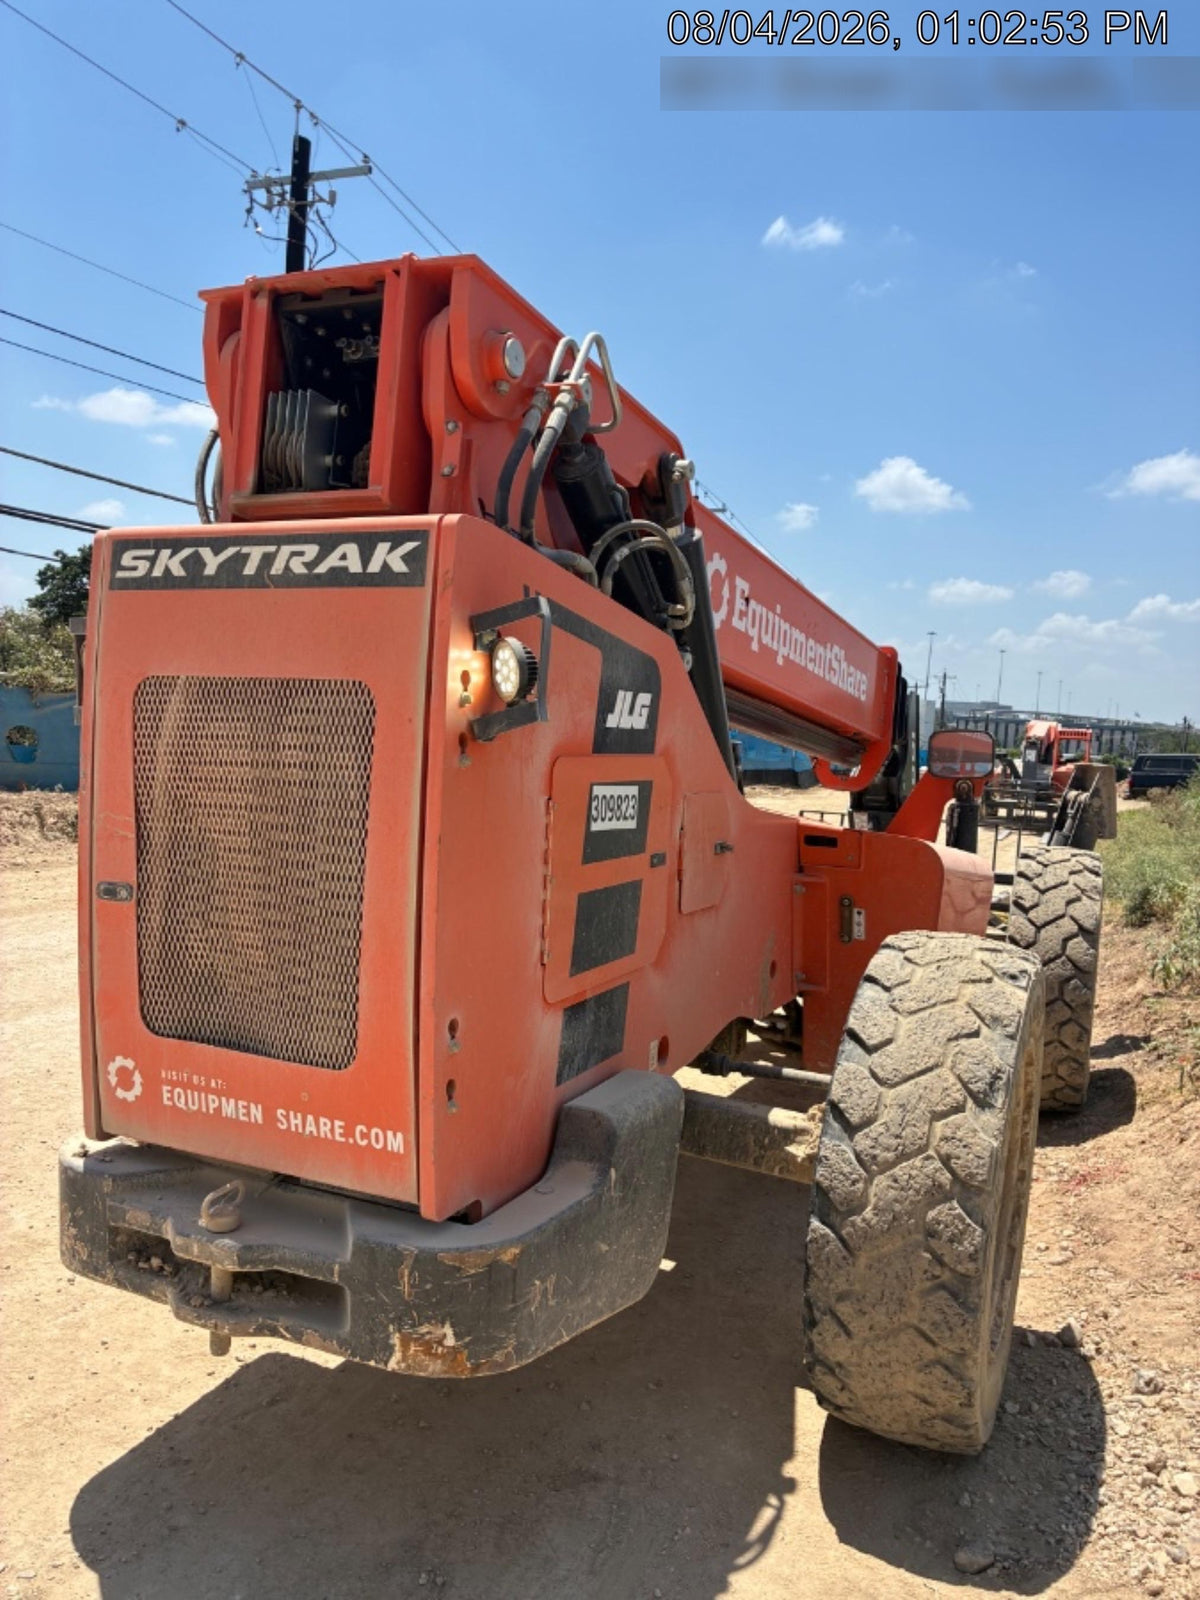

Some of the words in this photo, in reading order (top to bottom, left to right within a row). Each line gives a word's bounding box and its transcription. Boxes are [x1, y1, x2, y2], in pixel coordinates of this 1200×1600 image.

[115, 541, 421, 578] SKYTRAK
[732, 575, 868, 701] EquipmentShare
[605, 689, 652, 729] JLG
[591, 793, 637, 823] 309823
[193, 1075, 206, 1086] US
[210, 1079, 227, 1089] AT:
